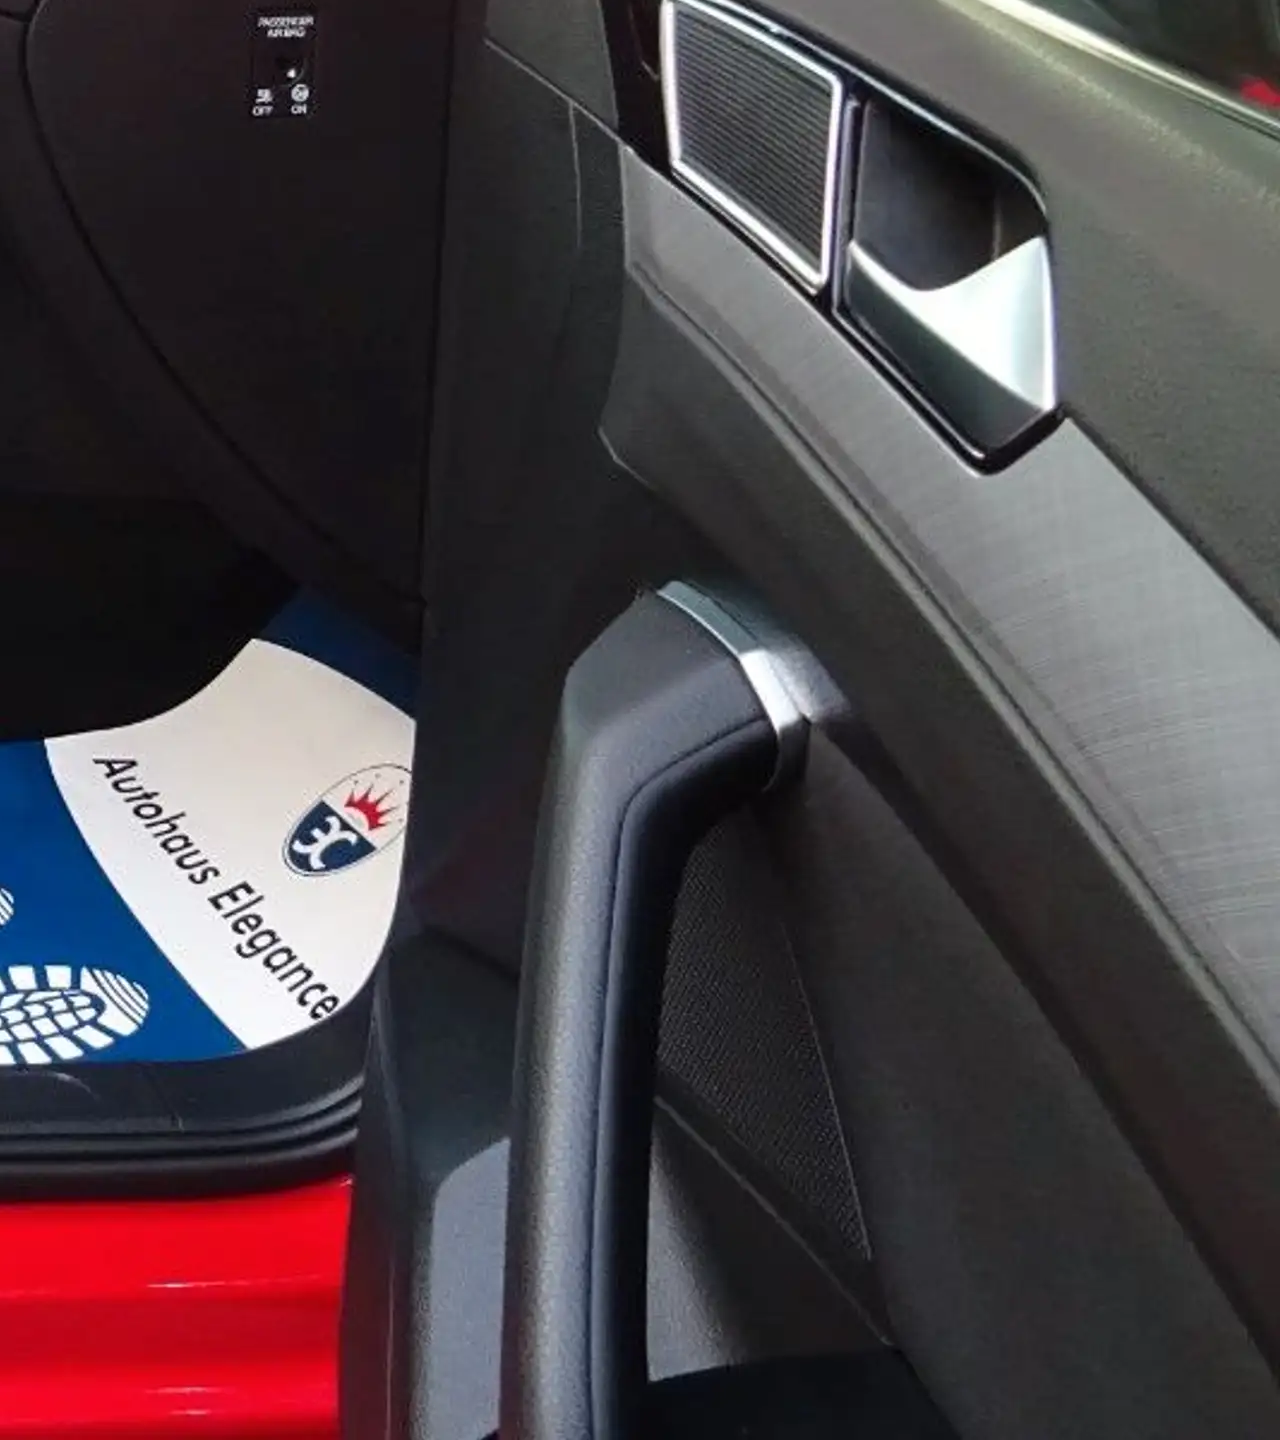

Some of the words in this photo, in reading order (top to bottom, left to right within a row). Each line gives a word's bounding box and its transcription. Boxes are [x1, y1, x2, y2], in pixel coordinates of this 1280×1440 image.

[252, 105, 274, 116] OFF
[290, 103, 307, 114] ON
[92, 758, 220, 885] Autohaus
[207, 881, 340, 1020] Elegance
